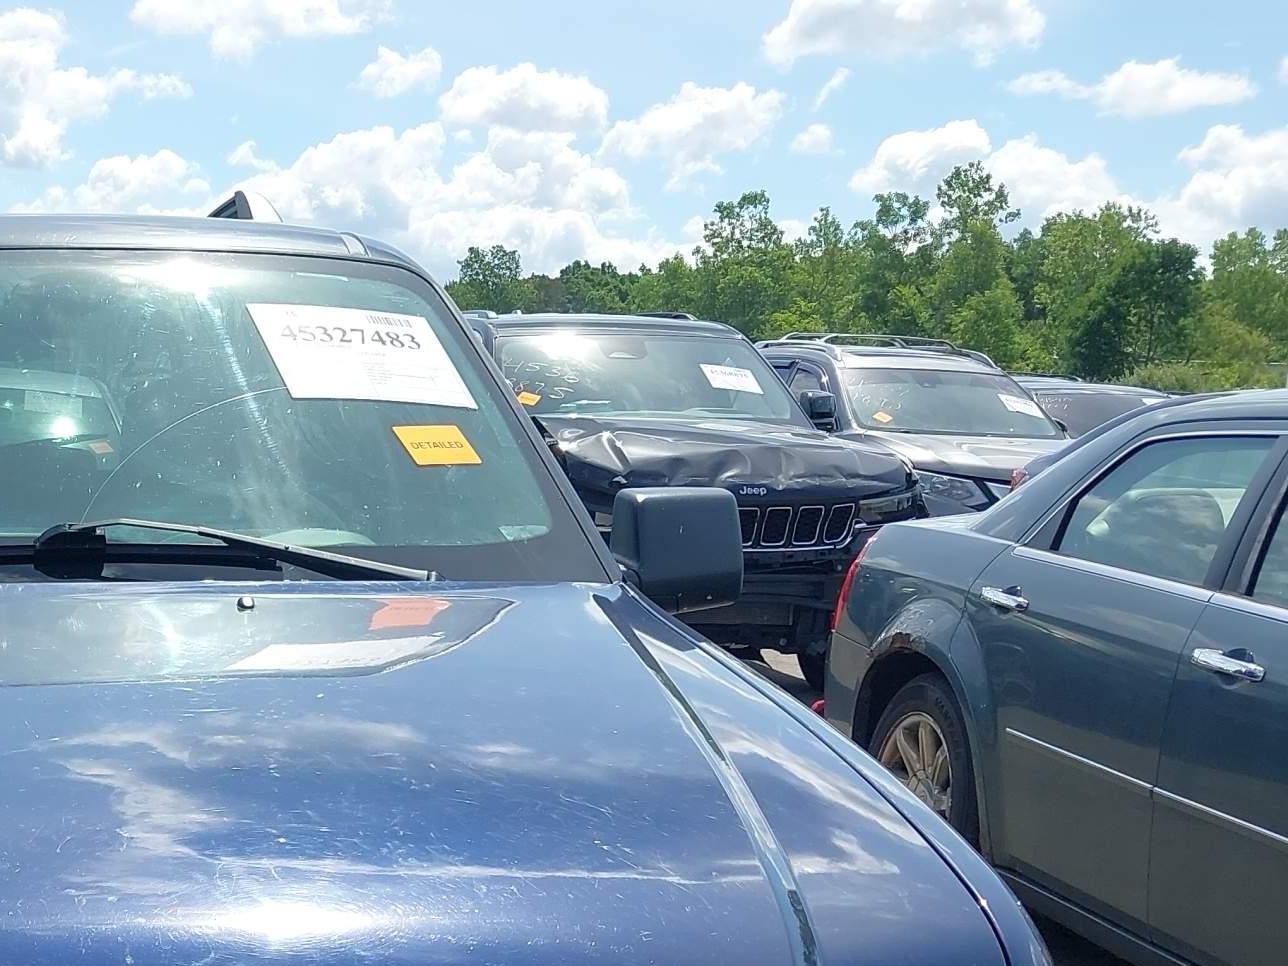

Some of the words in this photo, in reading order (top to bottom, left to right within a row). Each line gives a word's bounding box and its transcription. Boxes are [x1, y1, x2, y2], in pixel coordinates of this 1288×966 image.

[281, 324, 421, 350] 45327483
[410, 441, 463, 450] DETAILED
[739, 486, 767, 496] Jeep
